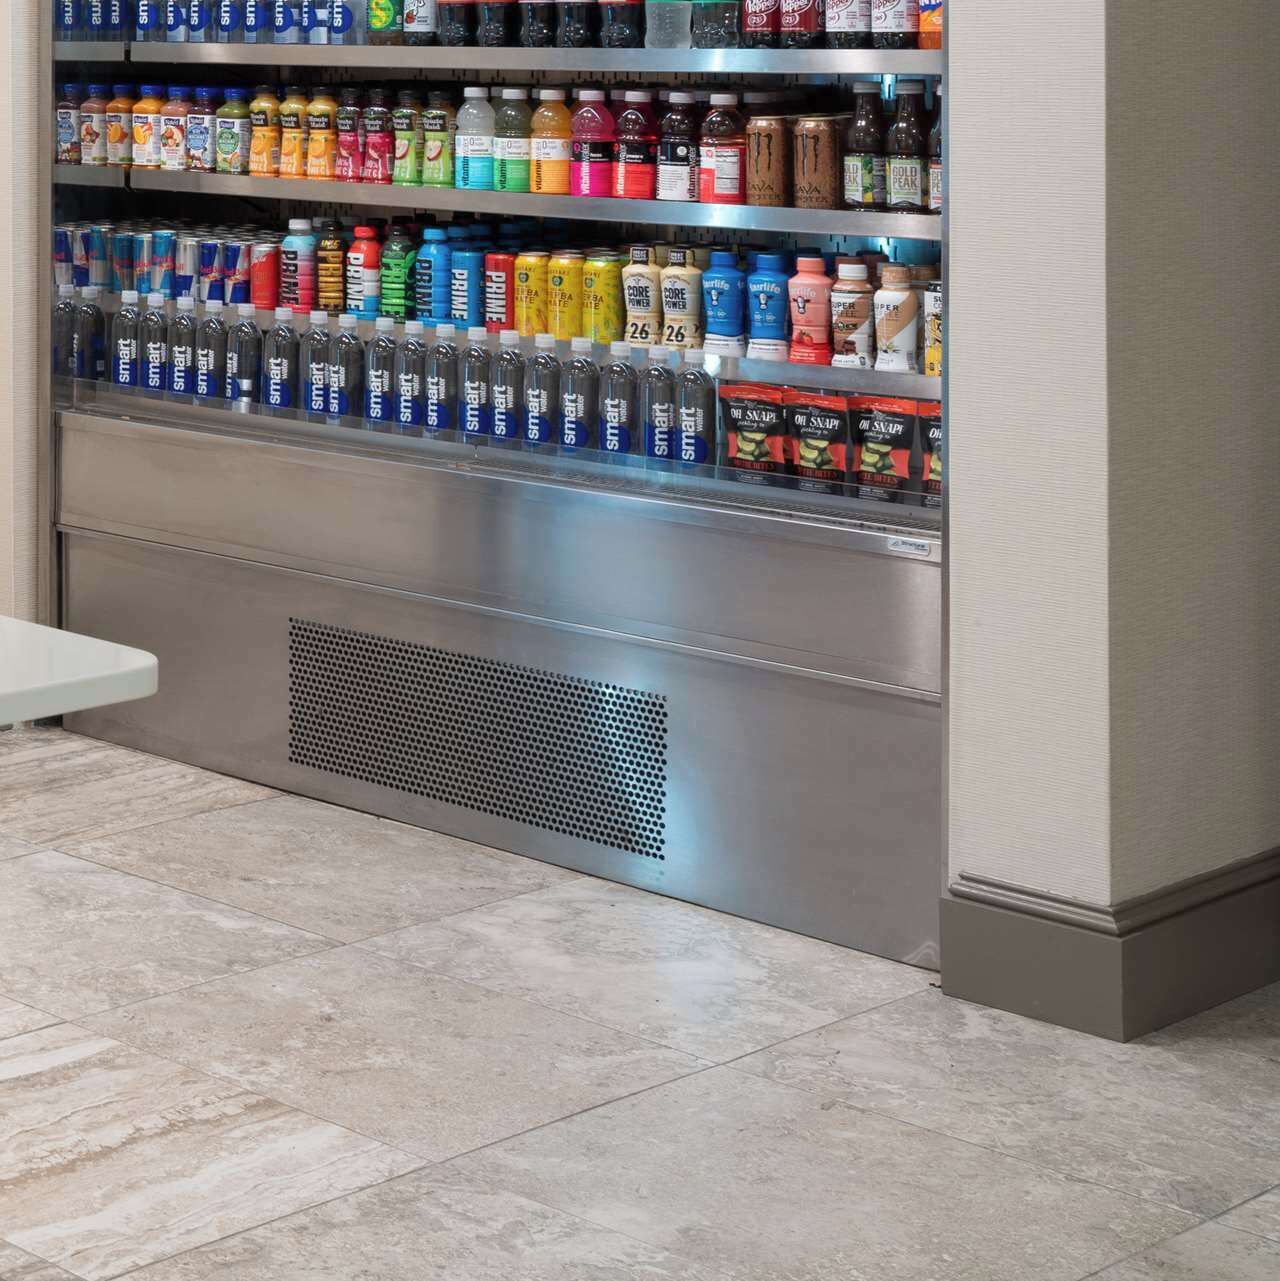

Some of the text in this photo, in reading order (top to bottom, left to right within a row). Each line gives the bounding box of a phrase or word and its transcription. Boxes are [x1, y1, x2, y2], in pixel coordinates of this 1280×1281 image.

[581, 142, 590, 194] vitaminwater
[618, 144, 627, 195] vitaminwater
[688, 145, 696, 199] vitaminwater
[892, 166, 916, 177] GOLD
[892, 176, 917, 187] PEAK
[347, 253, 365, 311] PRIME
[451, 269, 468, 320] PRIME
[485, 271, 506, 323] PRIME
[628, 286, 650, 298] CORE
[628, 298, 651, 308] POWER
[664, 288, 686, 300] CORE
[664, 300, 686, 310] POWER
[630, 323, 649, 339] 26
[666, 326, 685, 343] 26
[118, 338, 131, 383] smart
[148, 342, 161, 387] smart
[173, 345, 185, 391] smart
[196, 348, 208, 394] smart
[269, 357, 281, 404] smart
[311, 362, 324, 410] smart
[329, 365, 339, 413] smart
[369, 369, 383, 418] smart
[399, 373, 412, 423] smart
[427, 376, 438, 426] smart
[466, 381, 479, 432] smart
[494, 384, 506, 436] smart
[527, 388, 540, 440] smart
[564, 392, 576, 444] smart
[605, 398, 619, 451] smart
[655, 403, 668, 456] smart
[680, 406, 695, 461] smart
[730, 408, 777, 422] OH SNAP!
[795, 414, 839, 430] OH SNAP!
[859, 419, 903, 435] OH SNAP!
